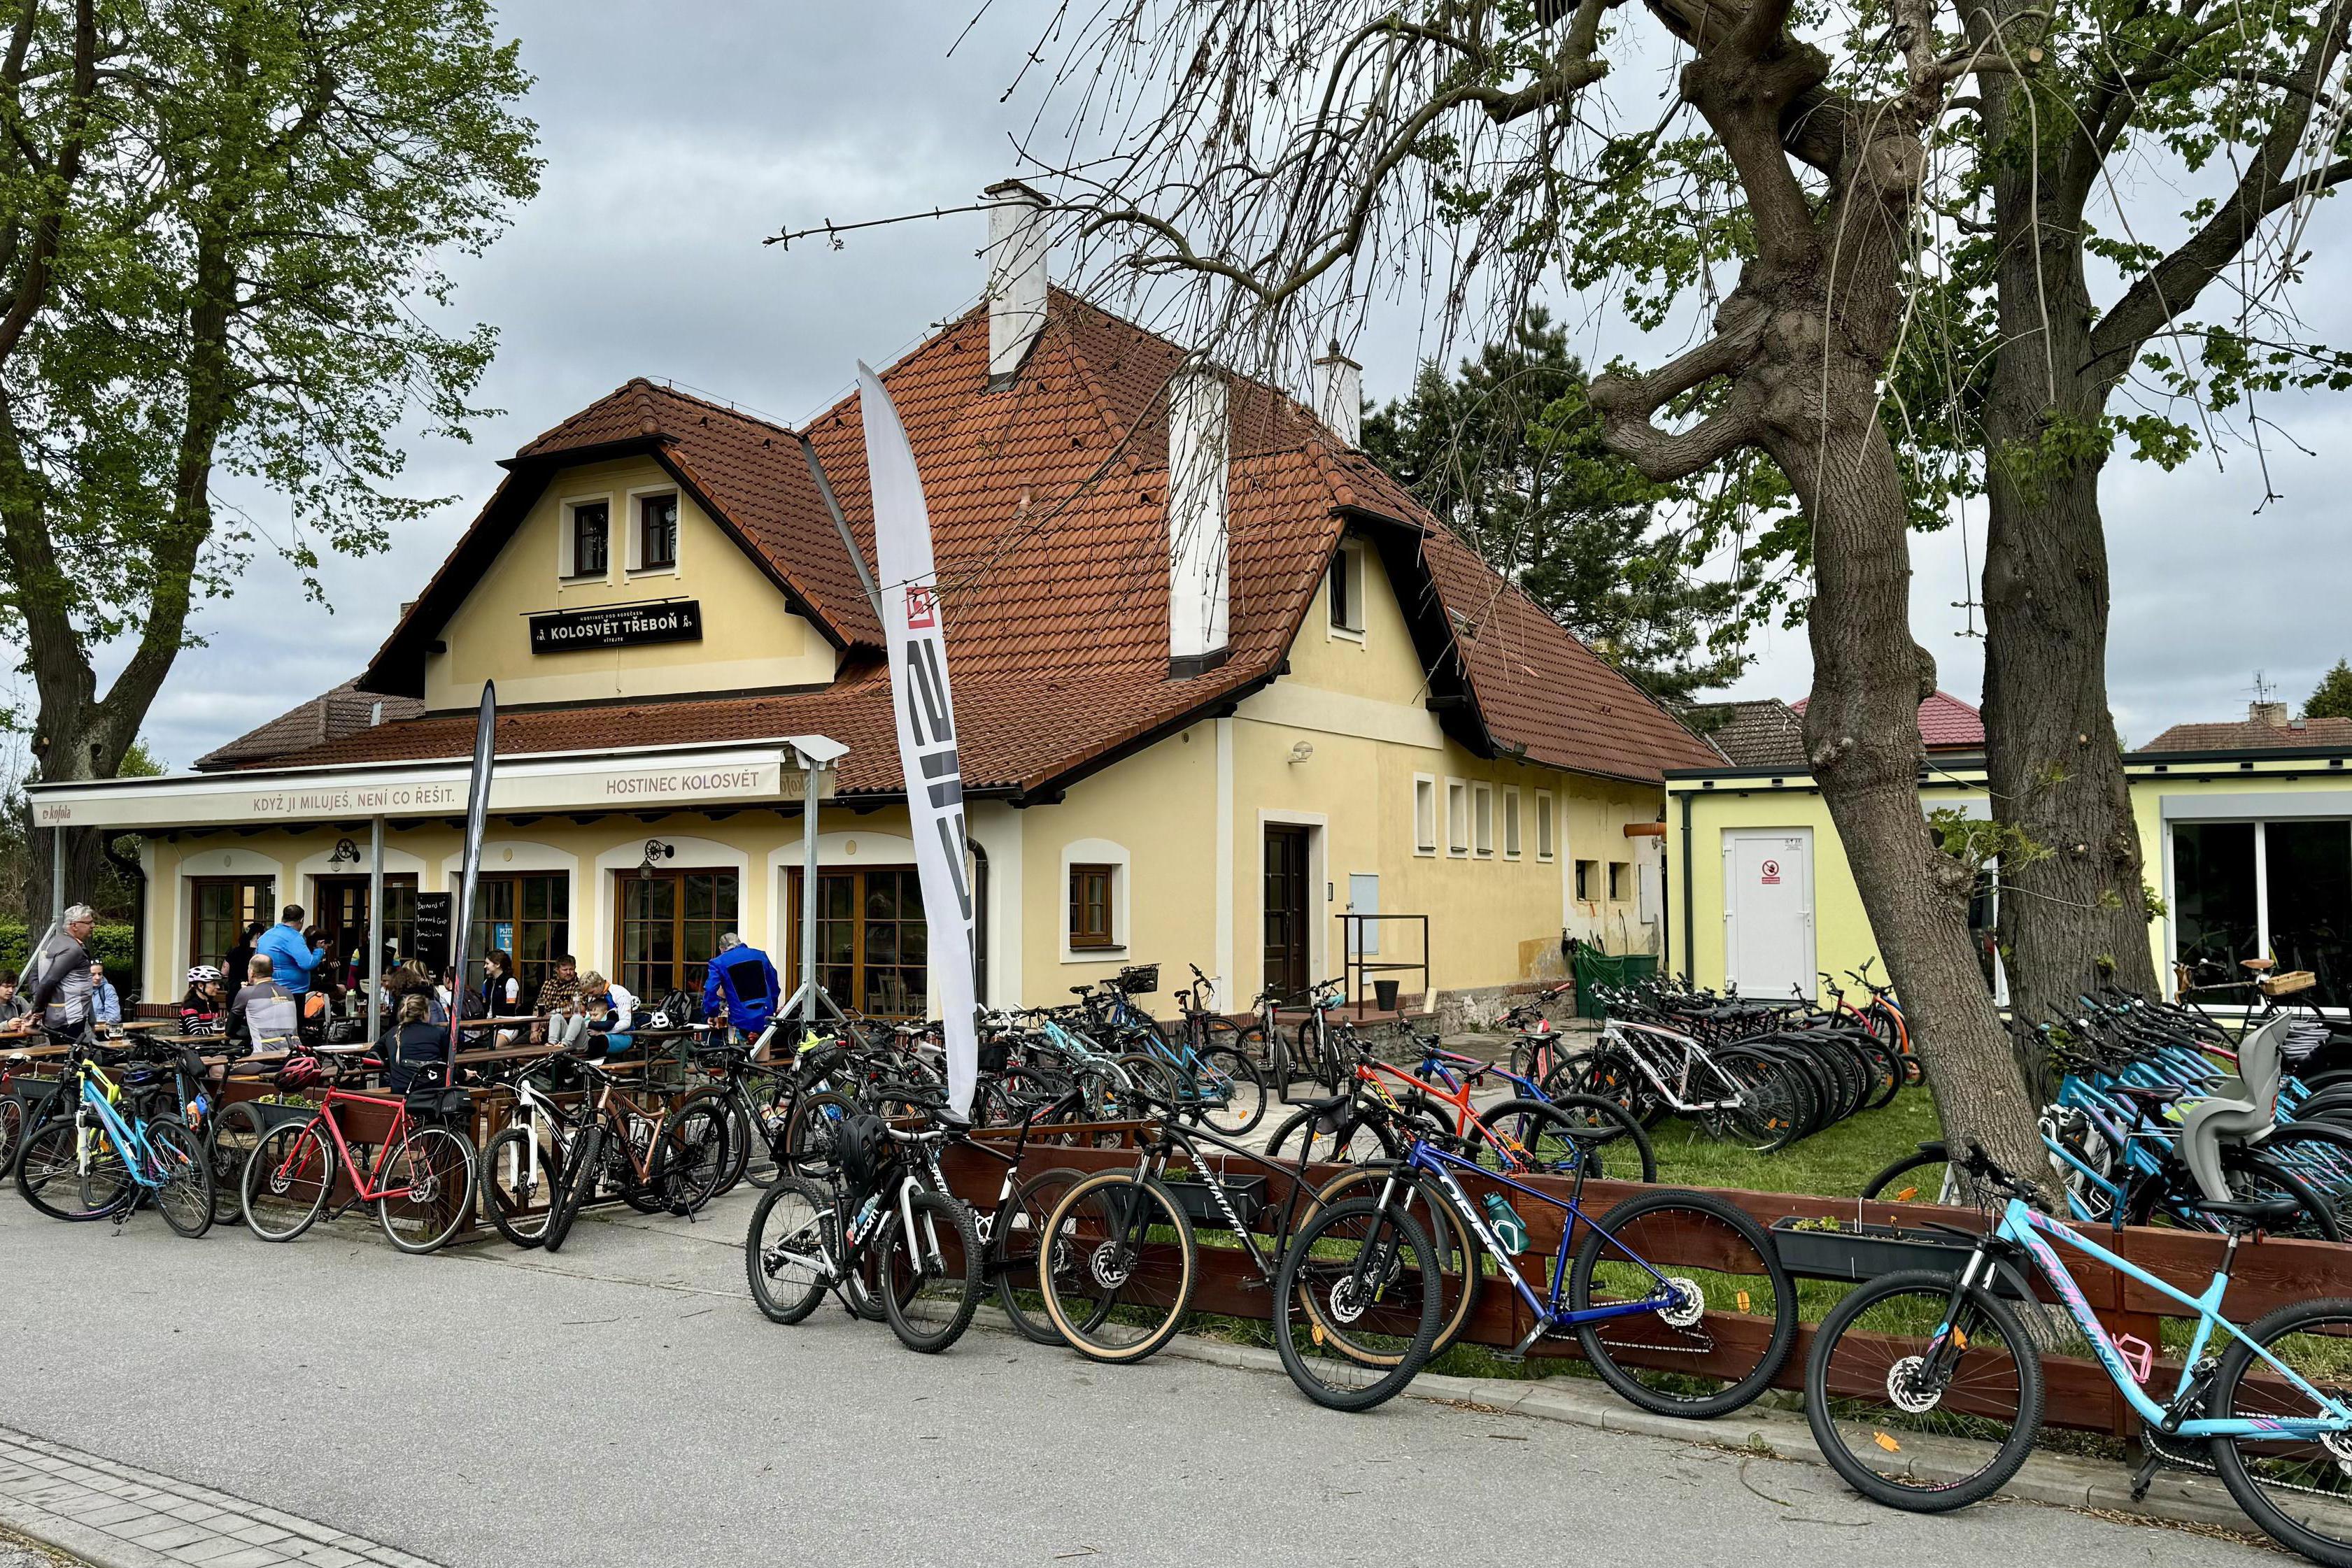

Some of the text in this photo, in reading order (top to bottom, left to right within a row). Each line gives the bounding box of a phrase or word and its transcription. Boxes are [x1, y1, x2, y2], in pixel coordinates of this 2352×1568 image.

[551, 612, 678, 640] KOLOSVĚT TŘEBOŇ
[607, 768, 759, 794] HOSTINEC KOLOSVĚT
[253, 785, 455, 813] KDYŽ JI MILUJEŠ, NENÍ CO ŘEŠIT.
[49, 805, 71, 823] kofola
[854, 1209, 879, 1245] woom
[1439, 1175, 1519, 1285] ORBEA
[2028, 1241, 2109, 1348] ROCK
